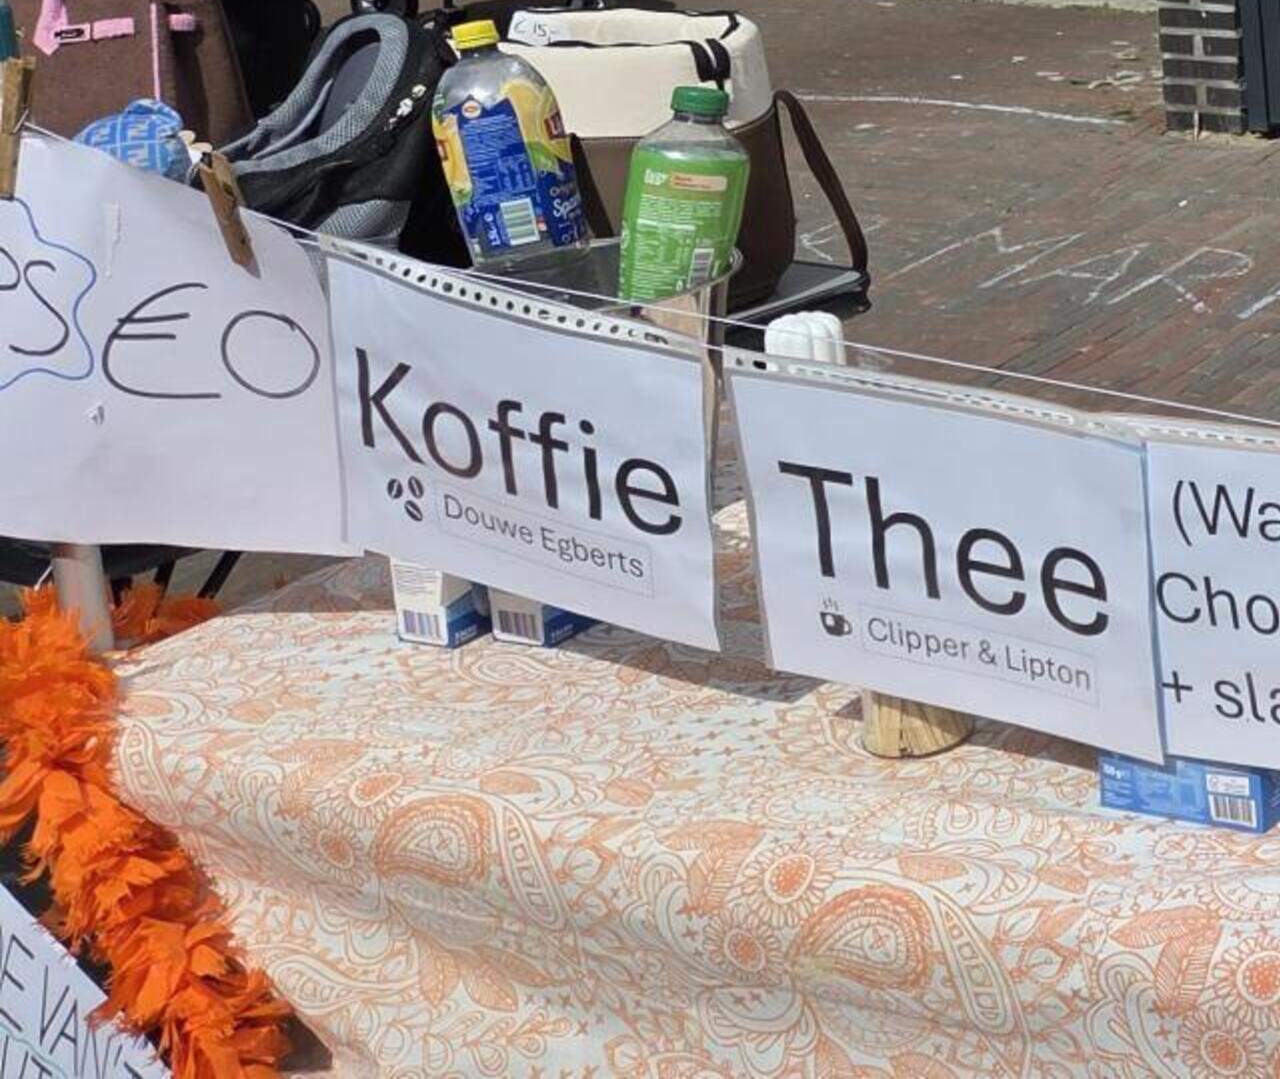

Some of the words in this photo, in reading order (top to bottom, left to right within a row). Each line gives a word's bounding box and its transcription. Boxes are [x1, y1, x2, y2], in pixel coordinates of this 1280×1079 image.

[355, 346, 683, 536] Koffie
[443, 493, 534, 545] Douwe
[541, 525, 645, 578] Egberts
[778, 460, 1110, 637] Thee
[867, 616, 970, 657] Clipper
[978, 638, 998, 665] &
[1006, 645, 1092, 691] Lipton
[1162, 671, 1193, 703] +
